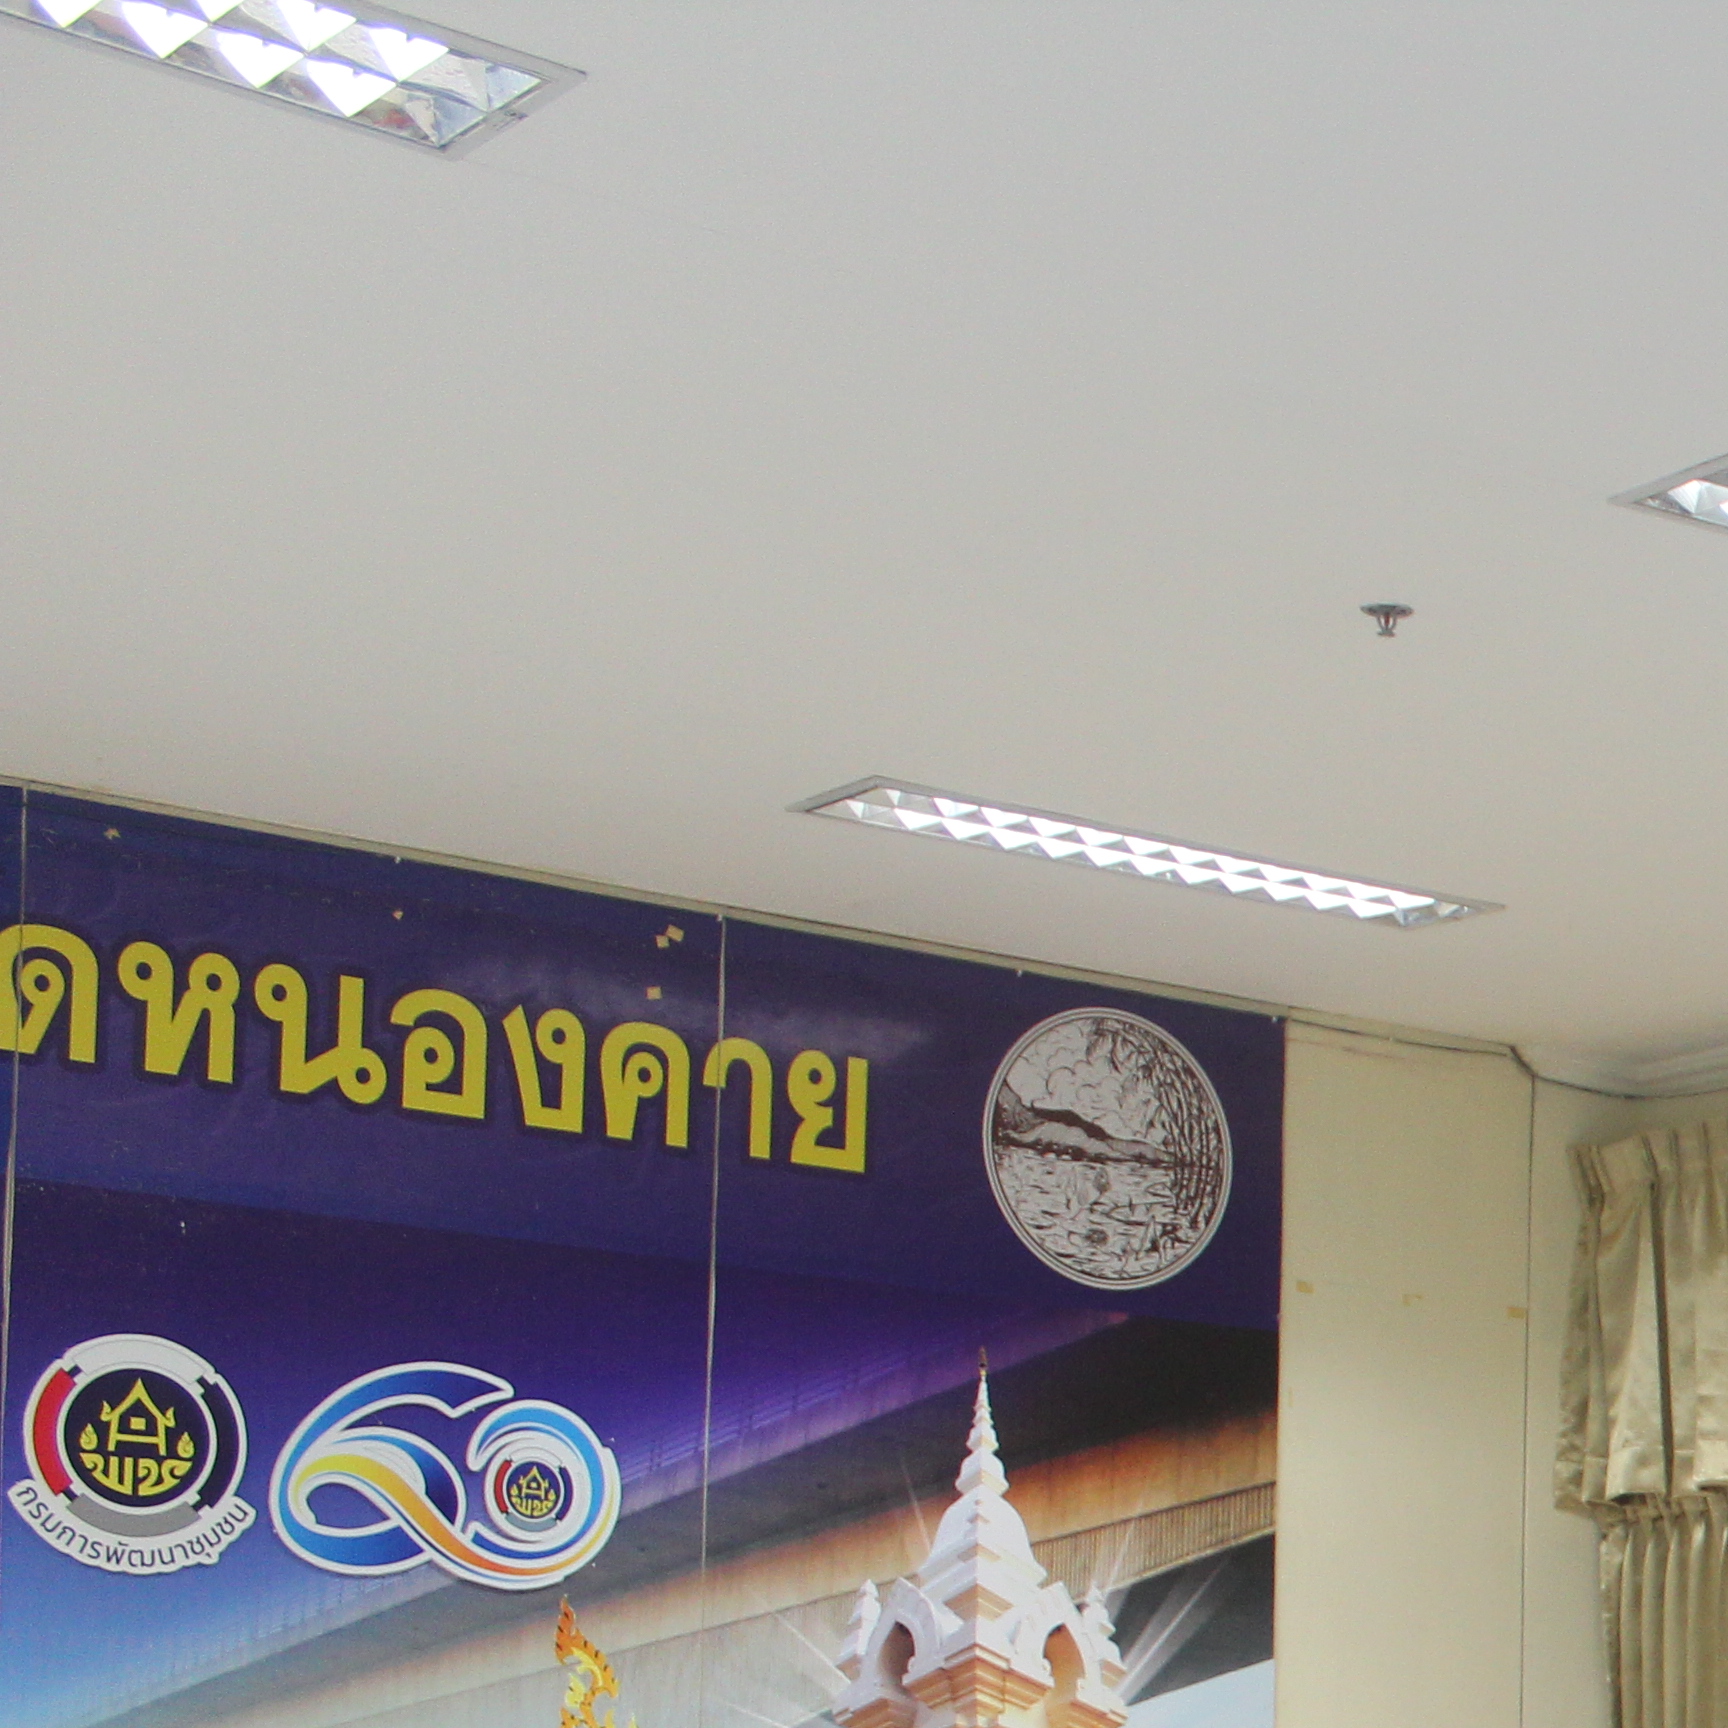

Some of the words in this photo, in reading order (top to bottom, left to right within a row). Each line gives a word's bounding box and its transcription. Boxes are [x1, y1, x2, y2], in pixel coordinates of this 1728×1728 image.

[16, 1485, 250, 1568] กรมการพัฒนาชุมชน
